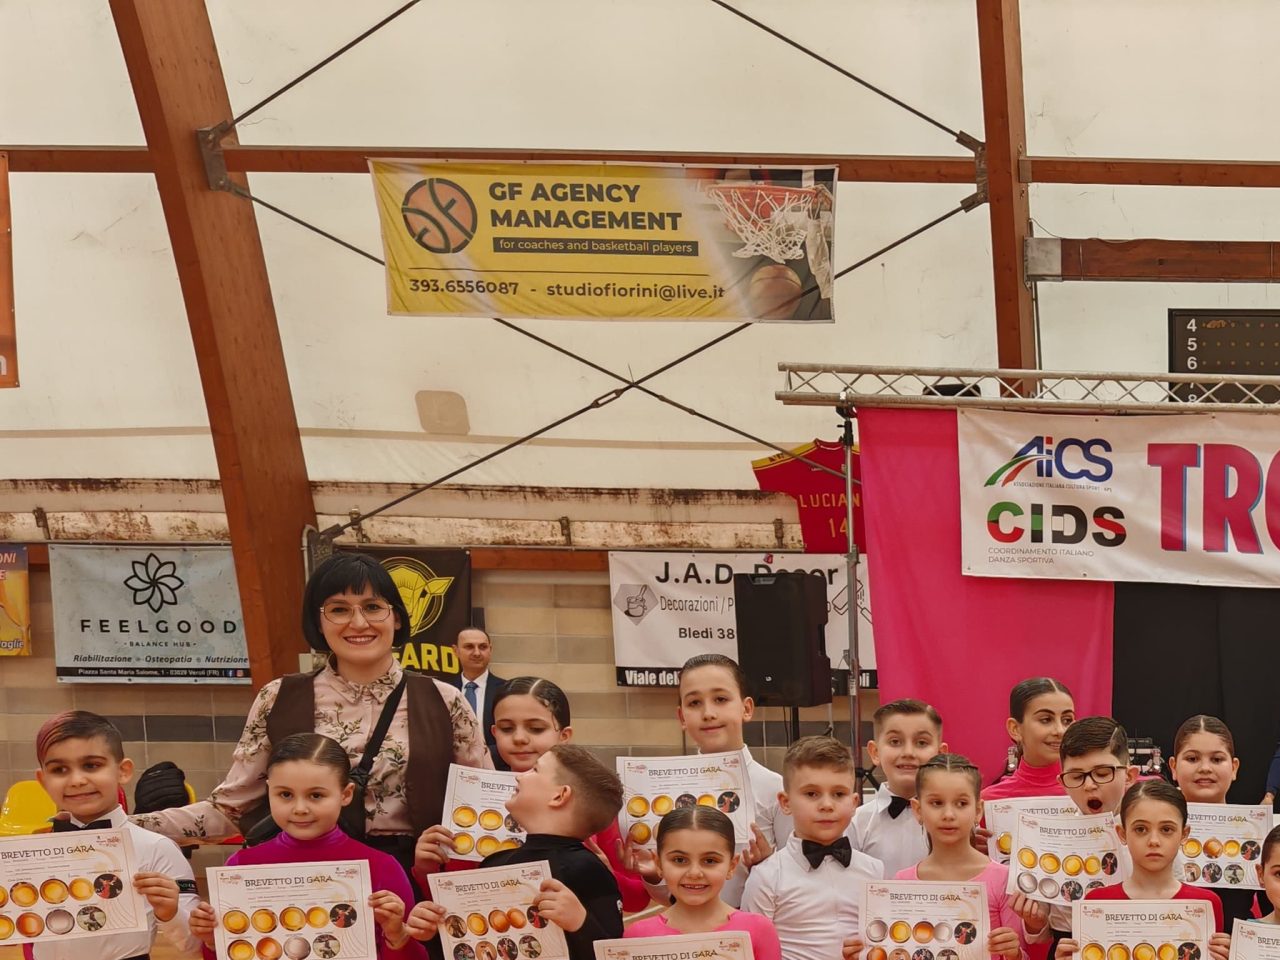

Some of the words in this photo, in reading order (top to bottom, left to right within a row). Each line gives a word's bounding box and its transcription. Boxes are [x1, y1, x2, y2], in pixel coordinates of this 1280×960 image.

[489, 182, 524, 201] GF
[532, 183, 640, 203] AGENCY
[491, 209, 682, 231] MANAGEMENT
[500, 239, 516, 250] for
[518, 240, 564, 251] coaches
[567, 240, 588, 251] and
[591, 241, 649, 253] basketball
[652, 242, 692, 255] players
[409, 279, 519, 296] 393.6556087
[547, 282, 725, 301] studiofiorini@live.it
[1187, 319, 1197, 332] 4
[1187, 337, 1197, 351] 5
[1187, 356, 1198, 370] 6
[987, 501, 1126, 547] CIDS
[988, 547, 1057, 555] COORDINAMENTO
[1059, 549, 1094, 557] ITALIANO
[660, 595, 719, 613] Decorazioni
[81, 619, 237, 634] FEELGOOD
[679, 628, 713, 640] Bledi
[73, 654, 132, 663] Riabilitazione
[145, 655, 192, 664] Osteopatia
[204, 655, 248, 664] Nutrizione
[625, 670, 657, 685] Viale
[1, 846, 51, 860] BREVETTO
[53, 847, 65, 855] DI
[244, 877, 292, 887] BREVETTO
[294, 876, 305, 884] DI
[1105, 913, 1147, 922] BREVETTO
[680, 952, 690, 960] DI
